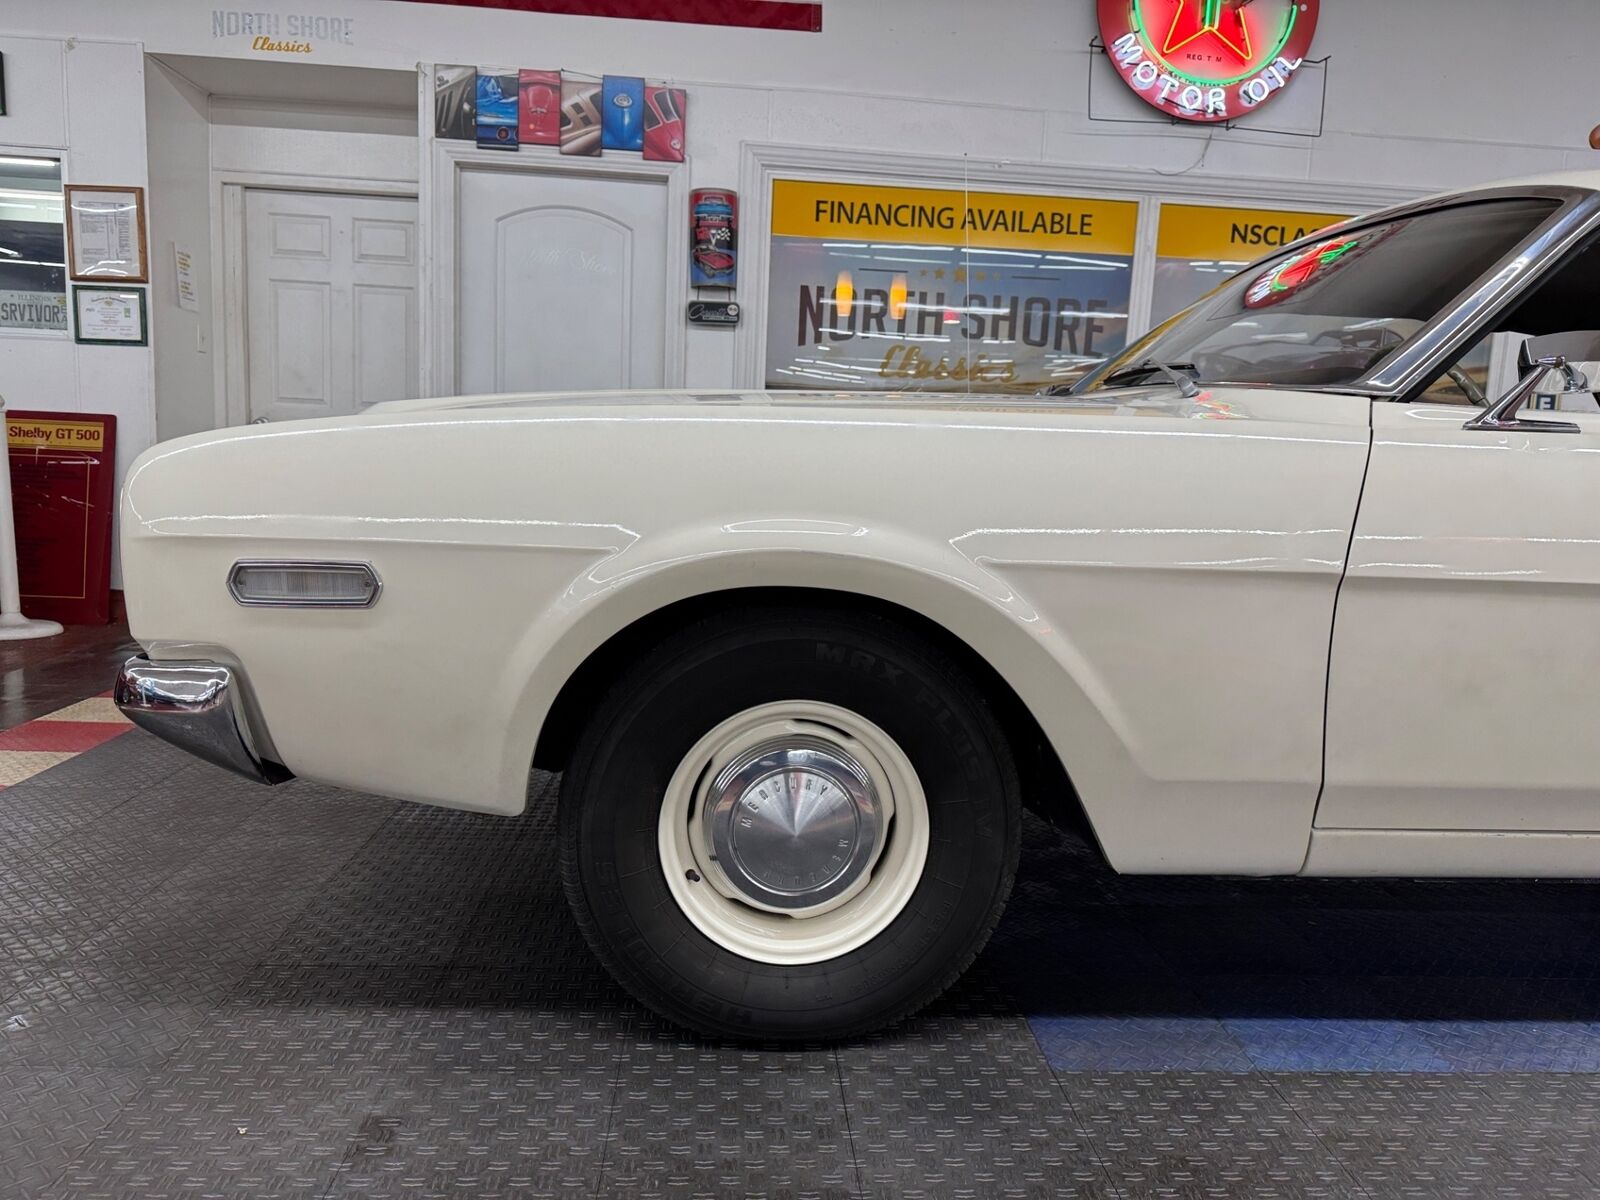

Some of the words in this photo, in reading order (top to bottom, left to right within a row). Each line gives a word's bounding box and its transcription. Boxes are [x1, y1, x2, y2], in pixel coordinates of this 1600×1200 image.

[212, 10, 280, 38] NORTH
[287, 14, 354, 46] SHORE
[252, 35, 313, 54] Classics
[1113, 32, 1227, 117] MOTOR
[1239, 57, 1303, 107] OIL
[814, 199, 955, 229] FINANCING
[961, 208, 1093, 236] AVAILABLE
[1230, 223, 1320, 247] NSCLA
[797, 284, 945, 347] NORTH
[960, 293, 1107, 357] SHORE
[877, 344, 1020, 383] Classics
[9, 426, 52, 442] Shelby
[56, 428, 74, 440] GT
[76, 429, 100, 441] 500
[741, 776, 828, 829] MERCURY
